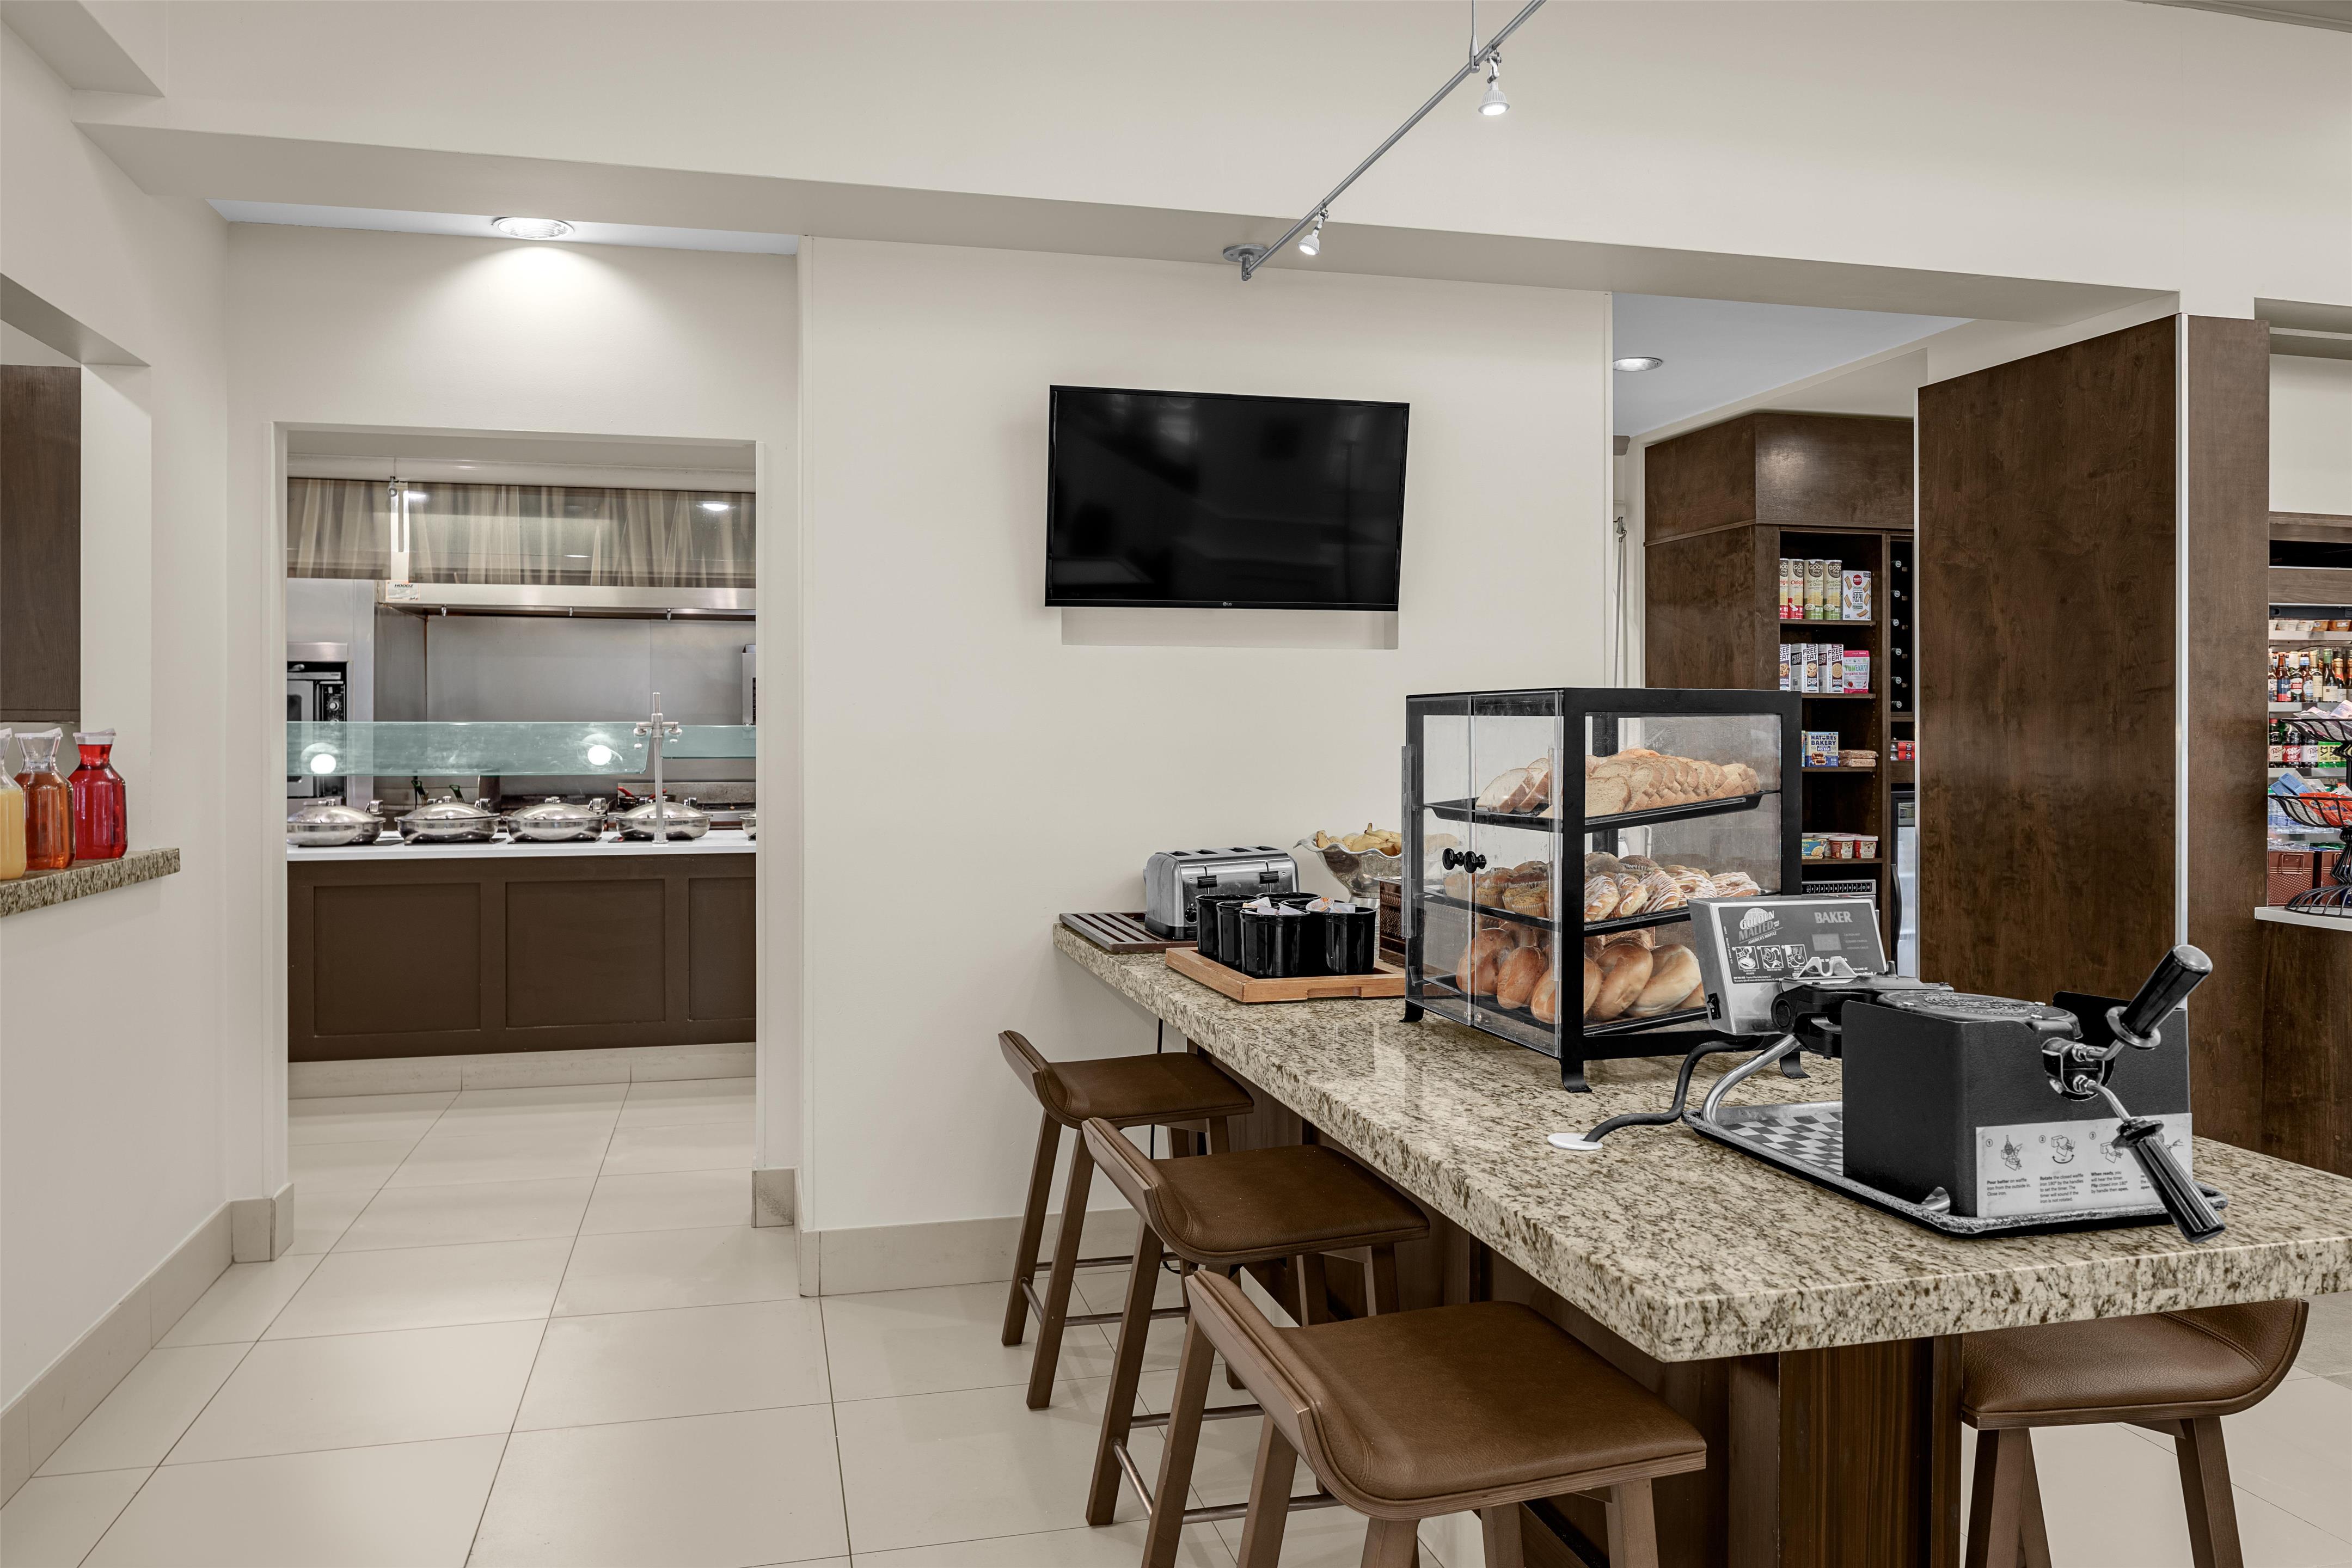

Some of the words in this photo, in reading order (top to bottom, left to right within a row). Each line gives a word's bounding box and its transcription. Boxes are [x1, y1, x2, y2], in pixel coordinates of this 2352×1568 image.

[1803, 647, 1817, 656] FREE
[1828, 647, 1843, 656] FREE
[1739, 910, 1774, 930] GOLDEN
[1814, 911, 1853, 923] BAKER
[1739, 920, 1773, 941] MALTED
[1748, 936, 1765, 945] AMERICA'S
